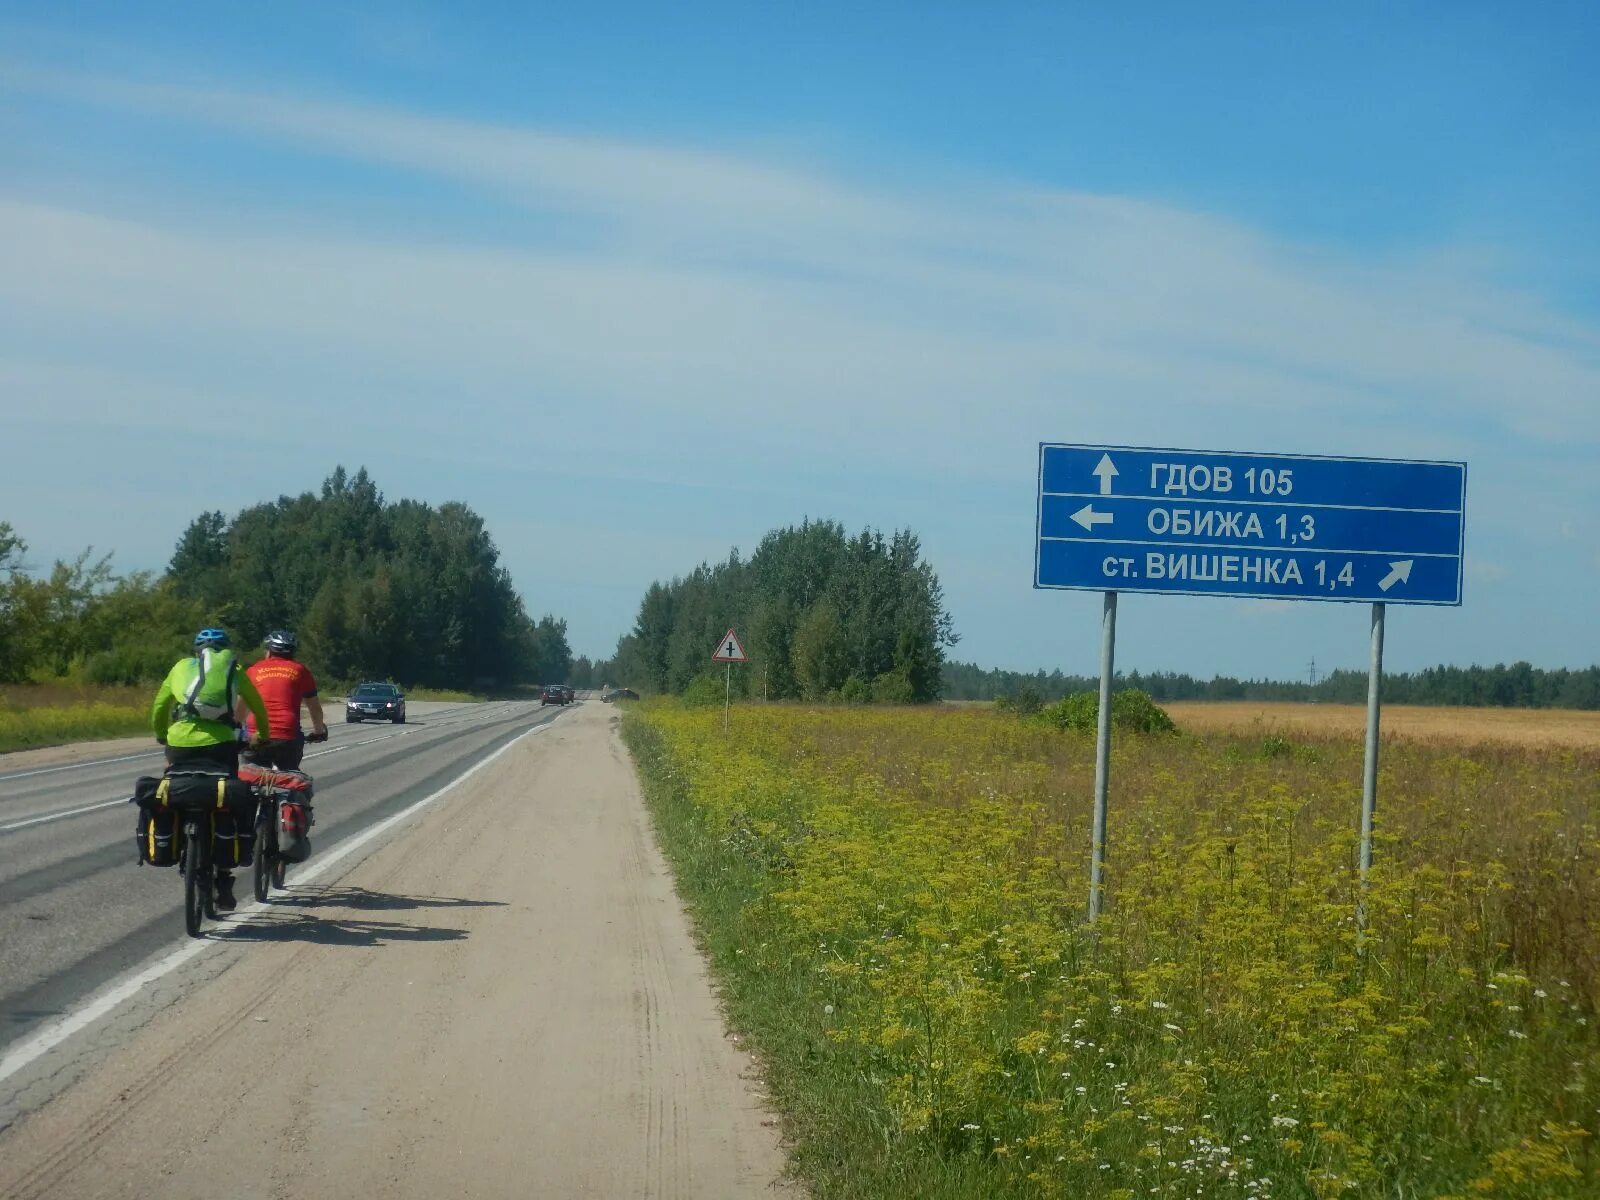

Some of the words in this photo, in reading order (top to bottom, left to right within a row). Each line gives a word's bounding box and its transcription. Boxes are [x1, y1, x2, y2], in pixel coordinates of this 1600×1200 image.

[1150, 463, 1233, 496] ГДОВ
[1244, 467, 1293, 496] 105
[1147, 507, 1264, 539] ОБИЖА
[1275, 513, 1315, 545] 1,3
[1102, 556, 1138, 578] ст.
[1146, 552, 1304, 585] ВИШЕНКА
[1314, 560, 1355, 591] 1,4
